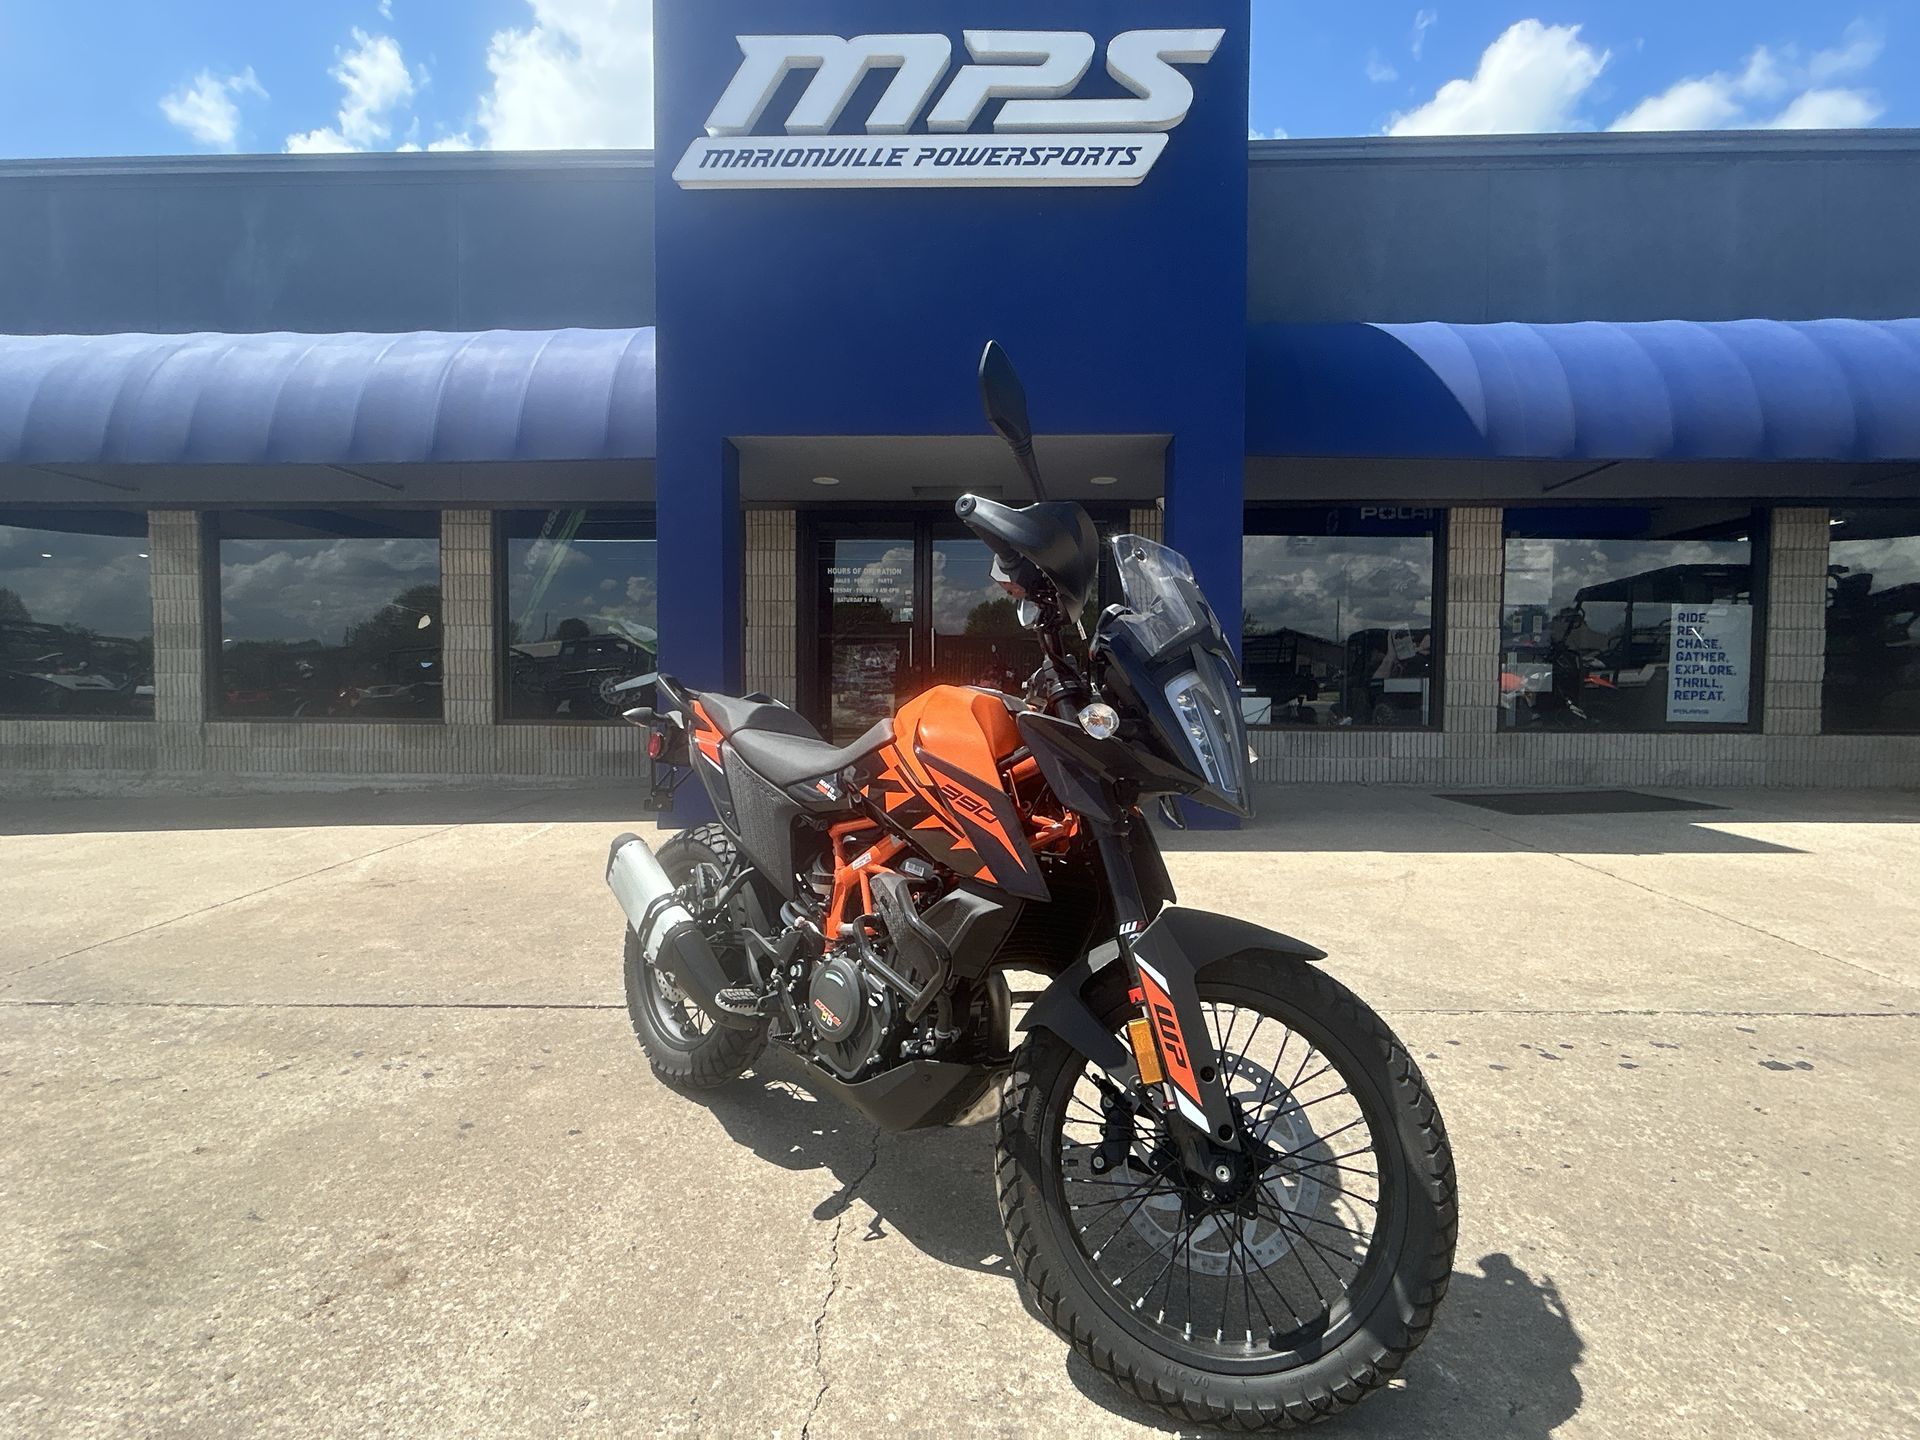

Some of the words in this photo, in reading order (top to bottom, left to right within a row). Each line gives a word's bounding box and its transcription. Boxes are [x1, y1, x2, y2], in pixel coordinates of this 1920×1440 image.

[704, 29, 1225, 136] MPS
[699, 147, 910, 168] MARIONVILLE
[913, 146, 1142, 166] POWERSPORTS
[1677, 612, 1710, 624] RIDE.
[1677, 625, 1705, 636] REV.
[1676, 638, 1722, 650] CHASE.
[1675, 651, 1729, 663] GATHER.
[1675, 664, 1737, 676] EXPLORE.
[1674, 677, 1723, 689] THRILL.
[1673, 690, 1726, 701] REPEAT.
[940, 783, 998, 824] 390
